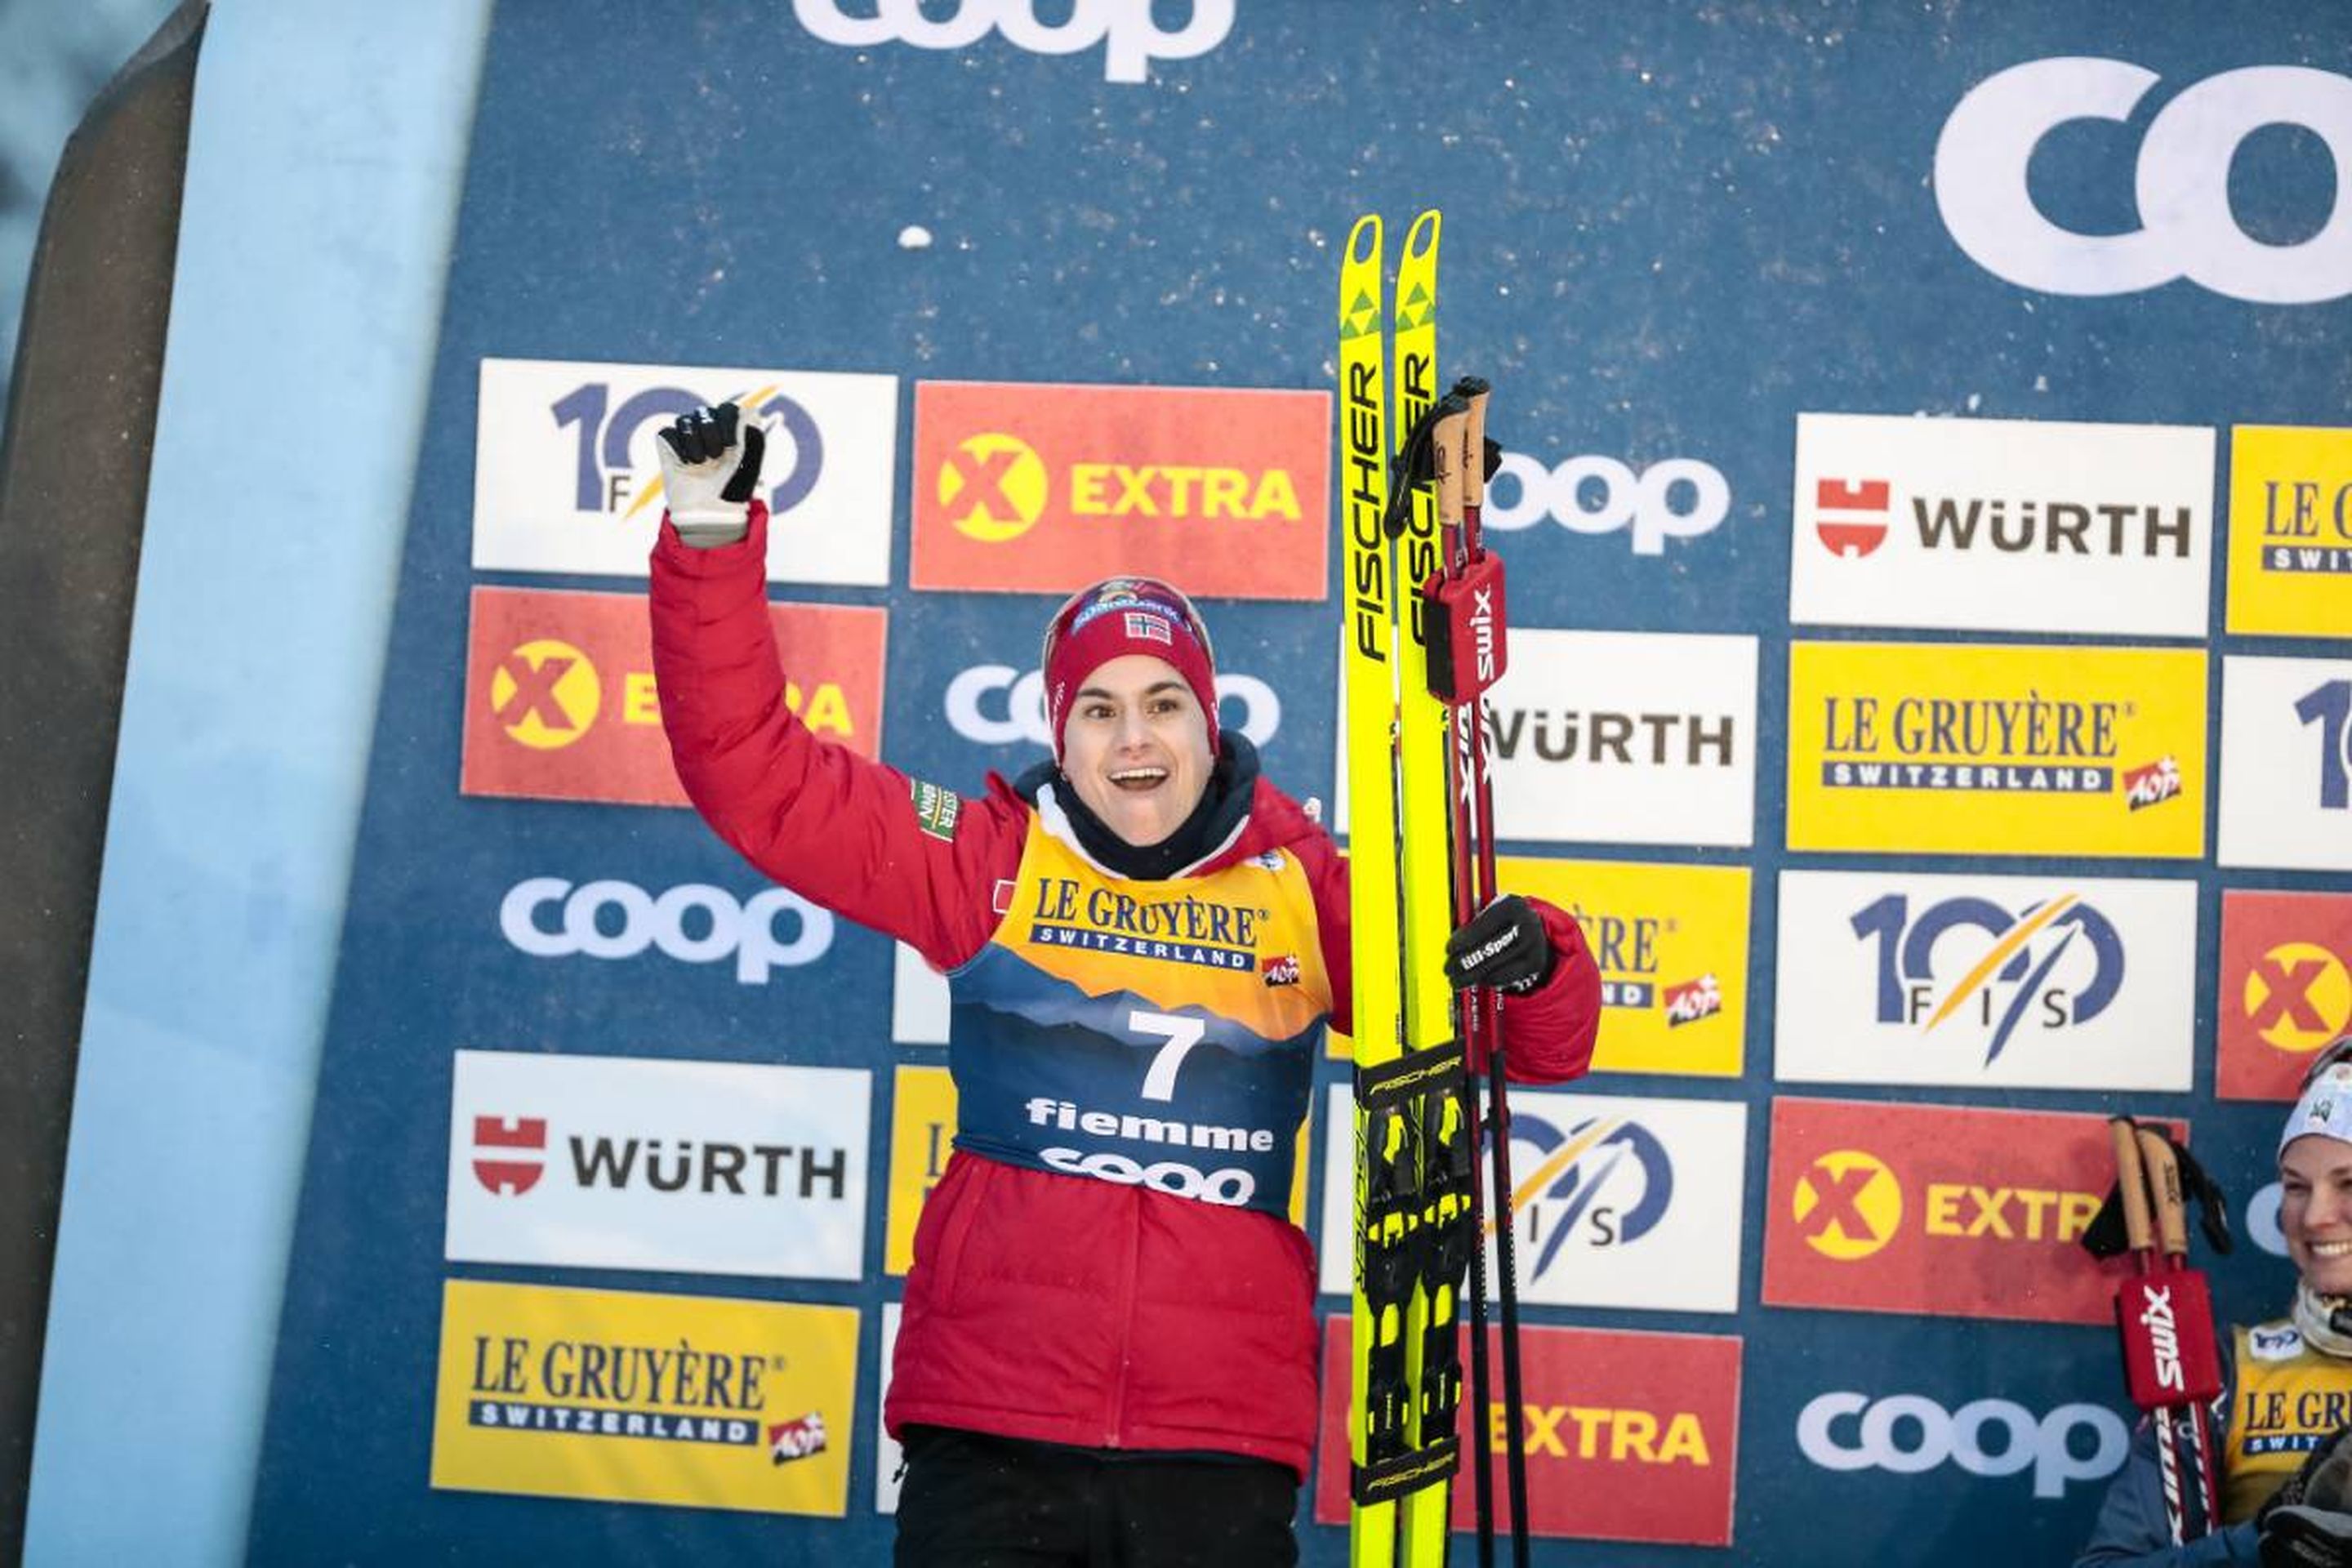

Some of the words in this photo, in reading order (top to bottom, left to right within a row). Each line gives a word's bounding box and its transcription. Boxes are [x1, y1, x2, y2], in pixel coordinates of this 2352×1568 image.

[1070, 463, 1303, 521] EXTRA
[1349, 360, 1387, 663] FISCHER
[1485, 452, 1731, 555] oop
[2264, 481, 2319, 537] LE
[1912, 497, 2192, 559] WÜRTH
[1470, 582, 1495, 683] swix
[1823, 697, 1879, 755] LE
[1893, 689, 2118, 759] GRUYÈRE
[1833, 763, 2104, 791] SWITZERLAND
[500, 877, 834, 984] coop
[1034, 877, 1080, 921] LE
[1087, 887, 1258, 948] GRUYÈRE
[1039, 927, 1246, 968] SWITZERLAND
[1849, 893, 2126, 1025] 100
[1909, 987, 2069, 1029] FIS
[1129, 1010, 1205, 1102] 7
[1026, 1098, 1274, 1152] fiemme
[569, 1135, 845, 1200] WÜRTH
[1530, 1205, 1615, 1248] IS
[1925, 1183, 2104, 1241] EXTR
[2140, 1285, 2185, 1392] swix
[472, 1336, 529, 1395] LE
[541, 1339, 767, 1411] GRUYÈRE
[480, 1403, 749, 1443] SWITZERLAND
[1489, 1401, 1711, 1465] EXTRA
[2247, 1392, 2286, 1430] LE
[1796, 1391, 2130, 1499] coop
